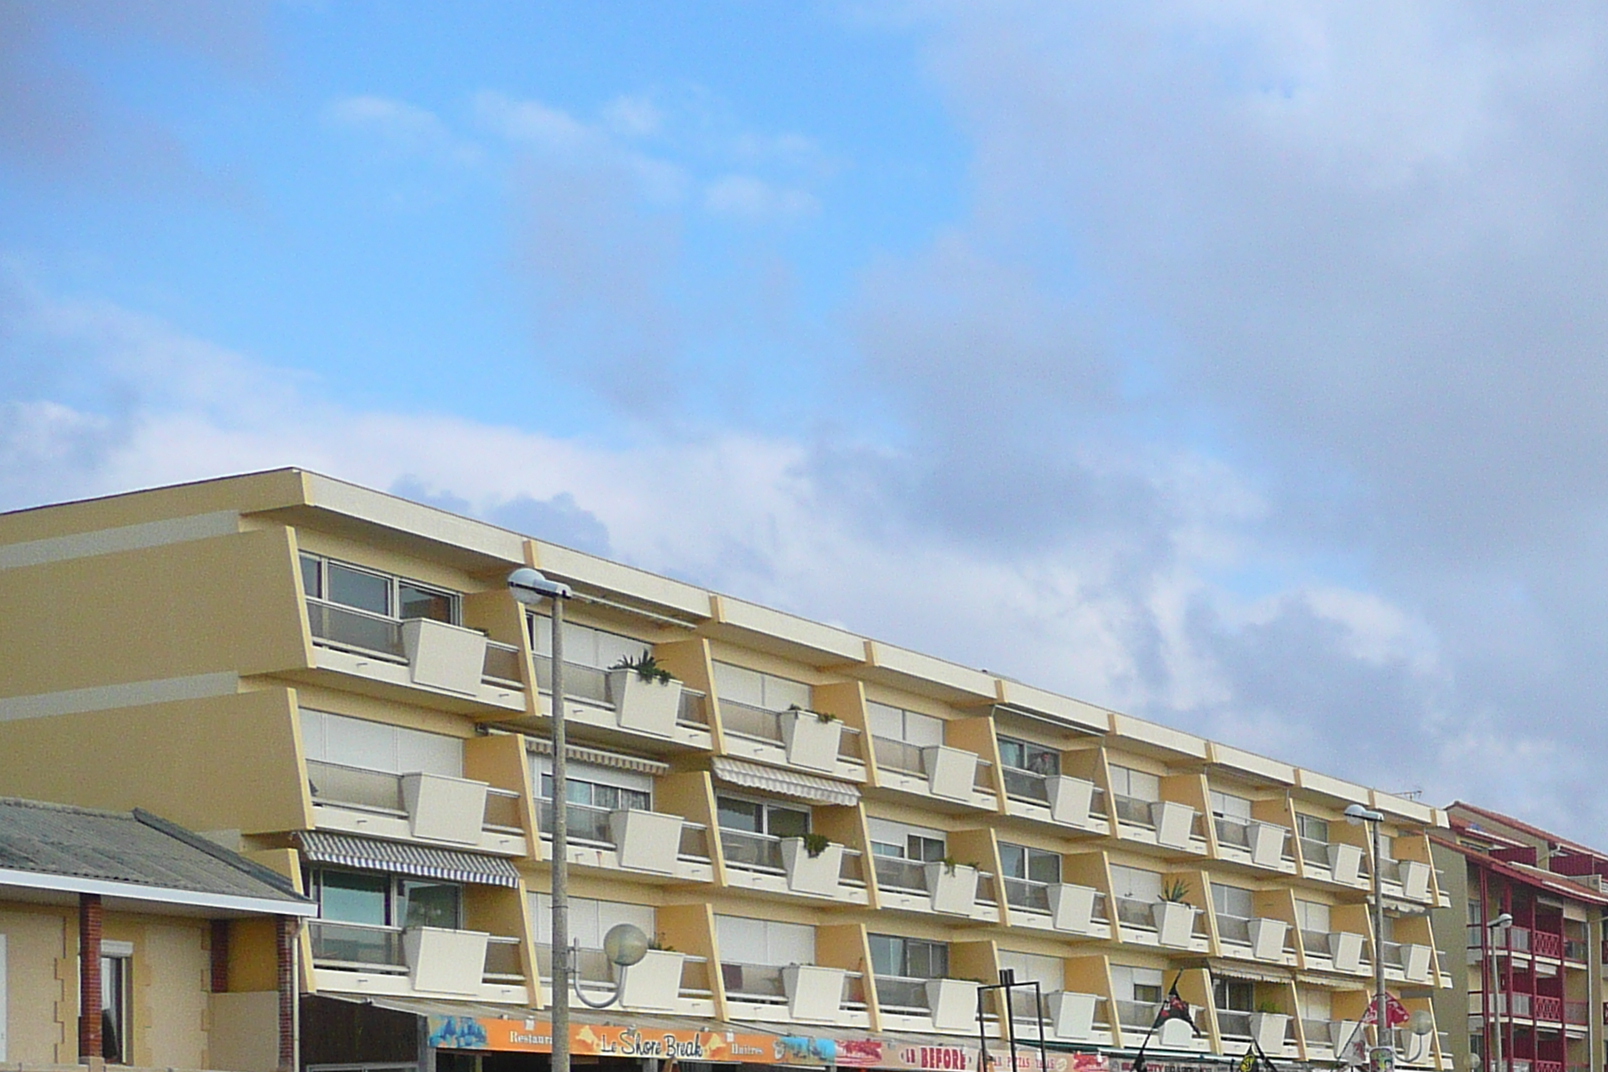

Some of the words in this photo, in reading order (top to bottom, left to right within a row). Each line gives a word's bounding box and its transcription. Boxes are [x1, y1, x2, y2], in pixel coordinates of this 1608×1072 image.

[600, 1034, 616, 1053] Le
[619, 1031, 661, 1055] Shore
[663, 1033, 703, 1057] Break
